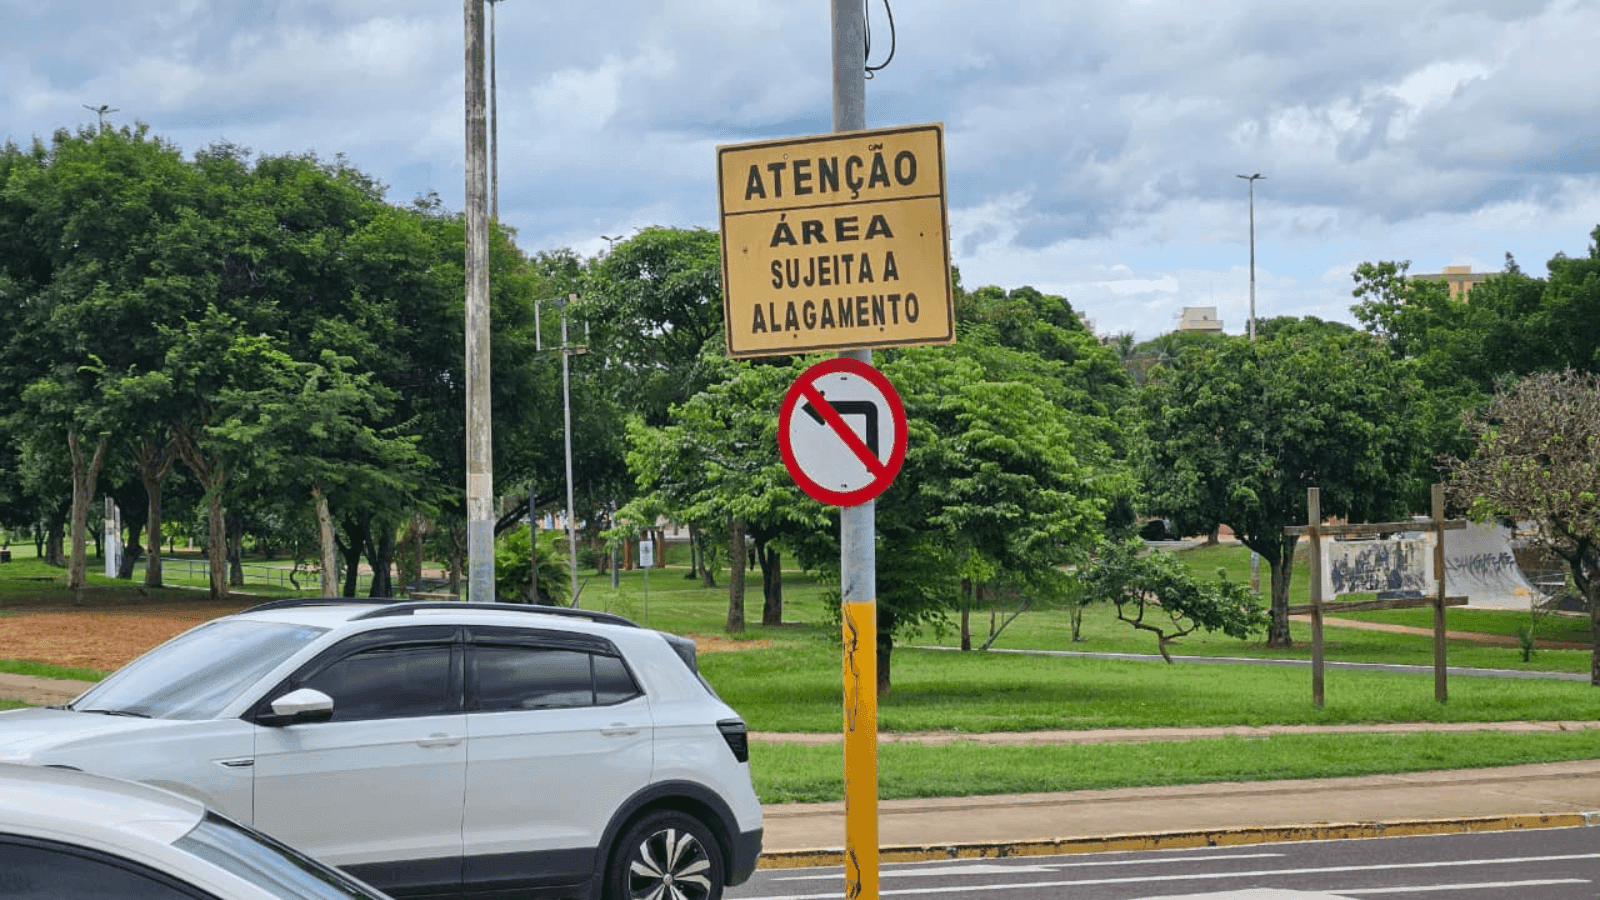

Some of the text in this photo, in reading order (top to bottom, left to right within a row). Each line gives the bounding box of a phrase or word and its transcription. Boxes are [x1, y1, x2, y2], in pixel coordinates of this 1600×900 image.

[745, 143, 917, 200] ATENÇÃO
[770, 213, 894, 248] ÁREA
[771, 251, 899, 290] SUJEITA A
[752, 292, 919, 334] ALAGAMENTO
